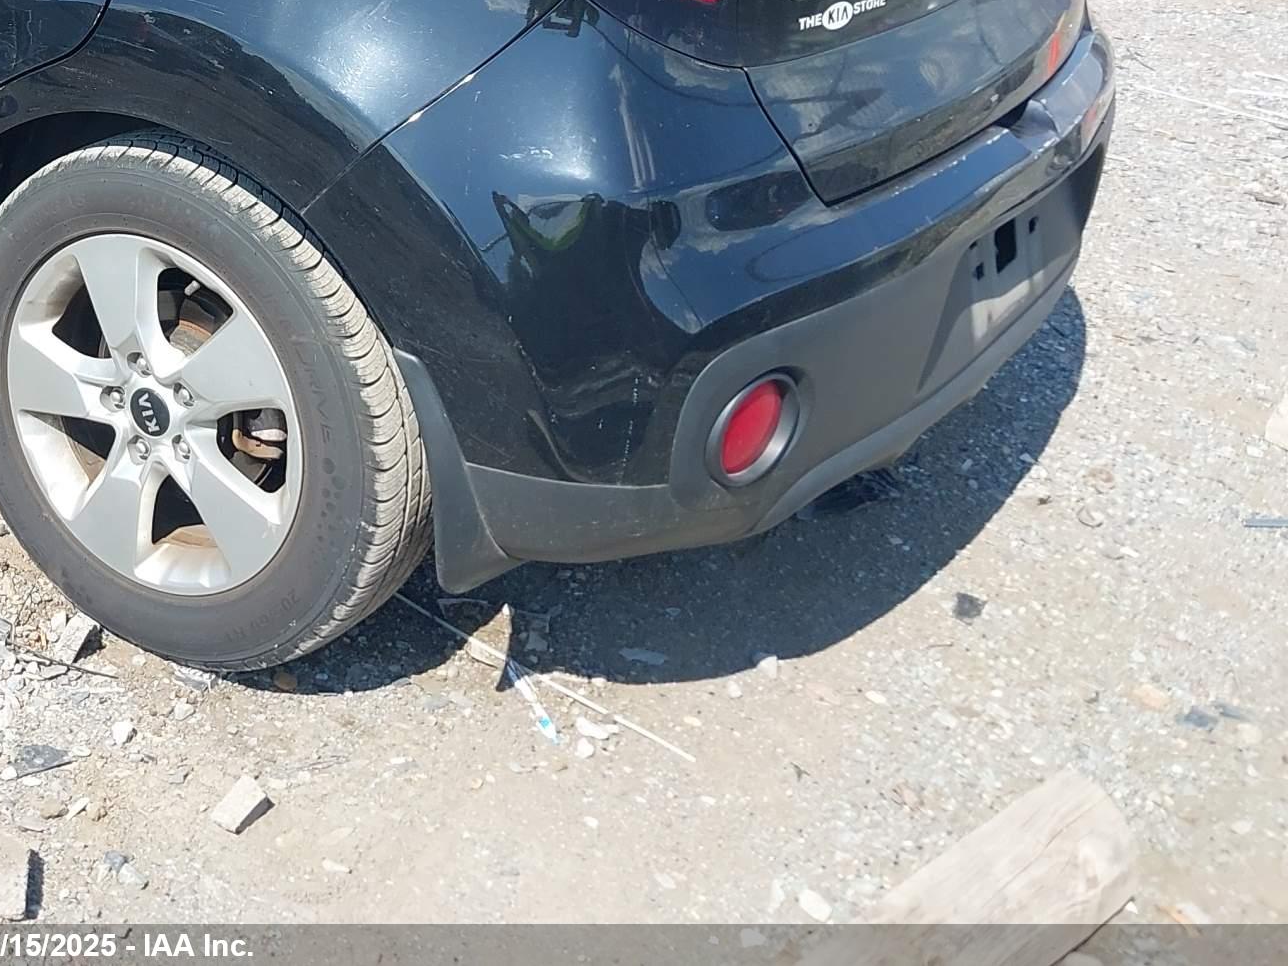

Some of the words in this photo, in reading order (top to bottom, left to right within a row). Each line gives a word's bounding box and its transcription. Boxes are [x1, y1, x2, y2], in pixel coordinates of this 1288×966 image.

[798, 13, 823, 31] THE
[826, 4, 851, 26] KIA
[138, 392, 161, 434] KIA
